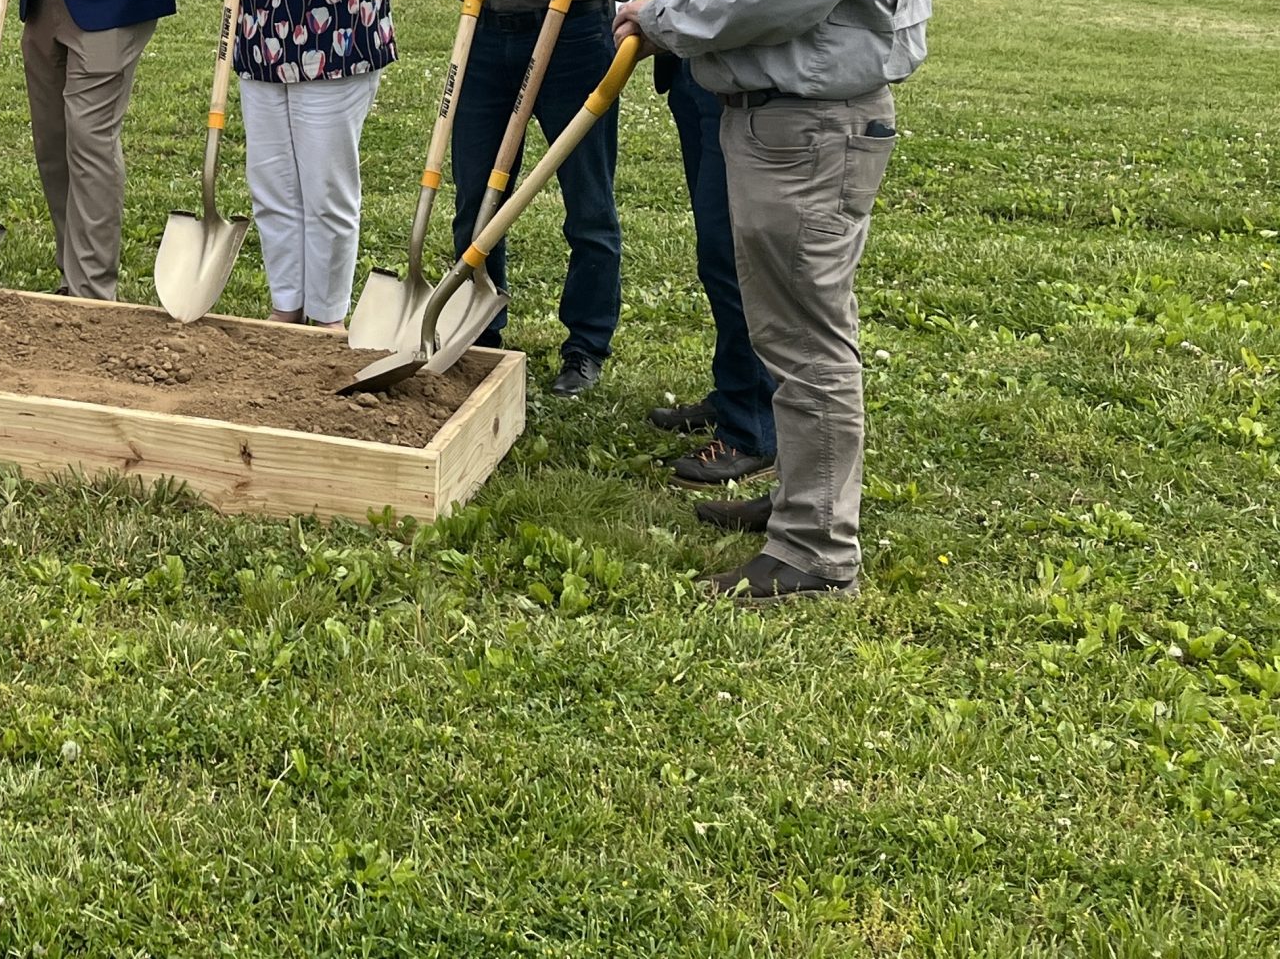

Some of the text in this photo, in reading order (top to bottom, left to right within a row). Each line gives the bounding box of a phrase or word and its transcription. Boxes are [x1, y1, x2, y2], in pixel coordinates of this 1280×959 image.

[218, 6, 232, 61] TRUE TEMPER
[439, 63, 458, 118] TRUE TEMPER
[513, 57, 535, 114] TRUE TEMPER
